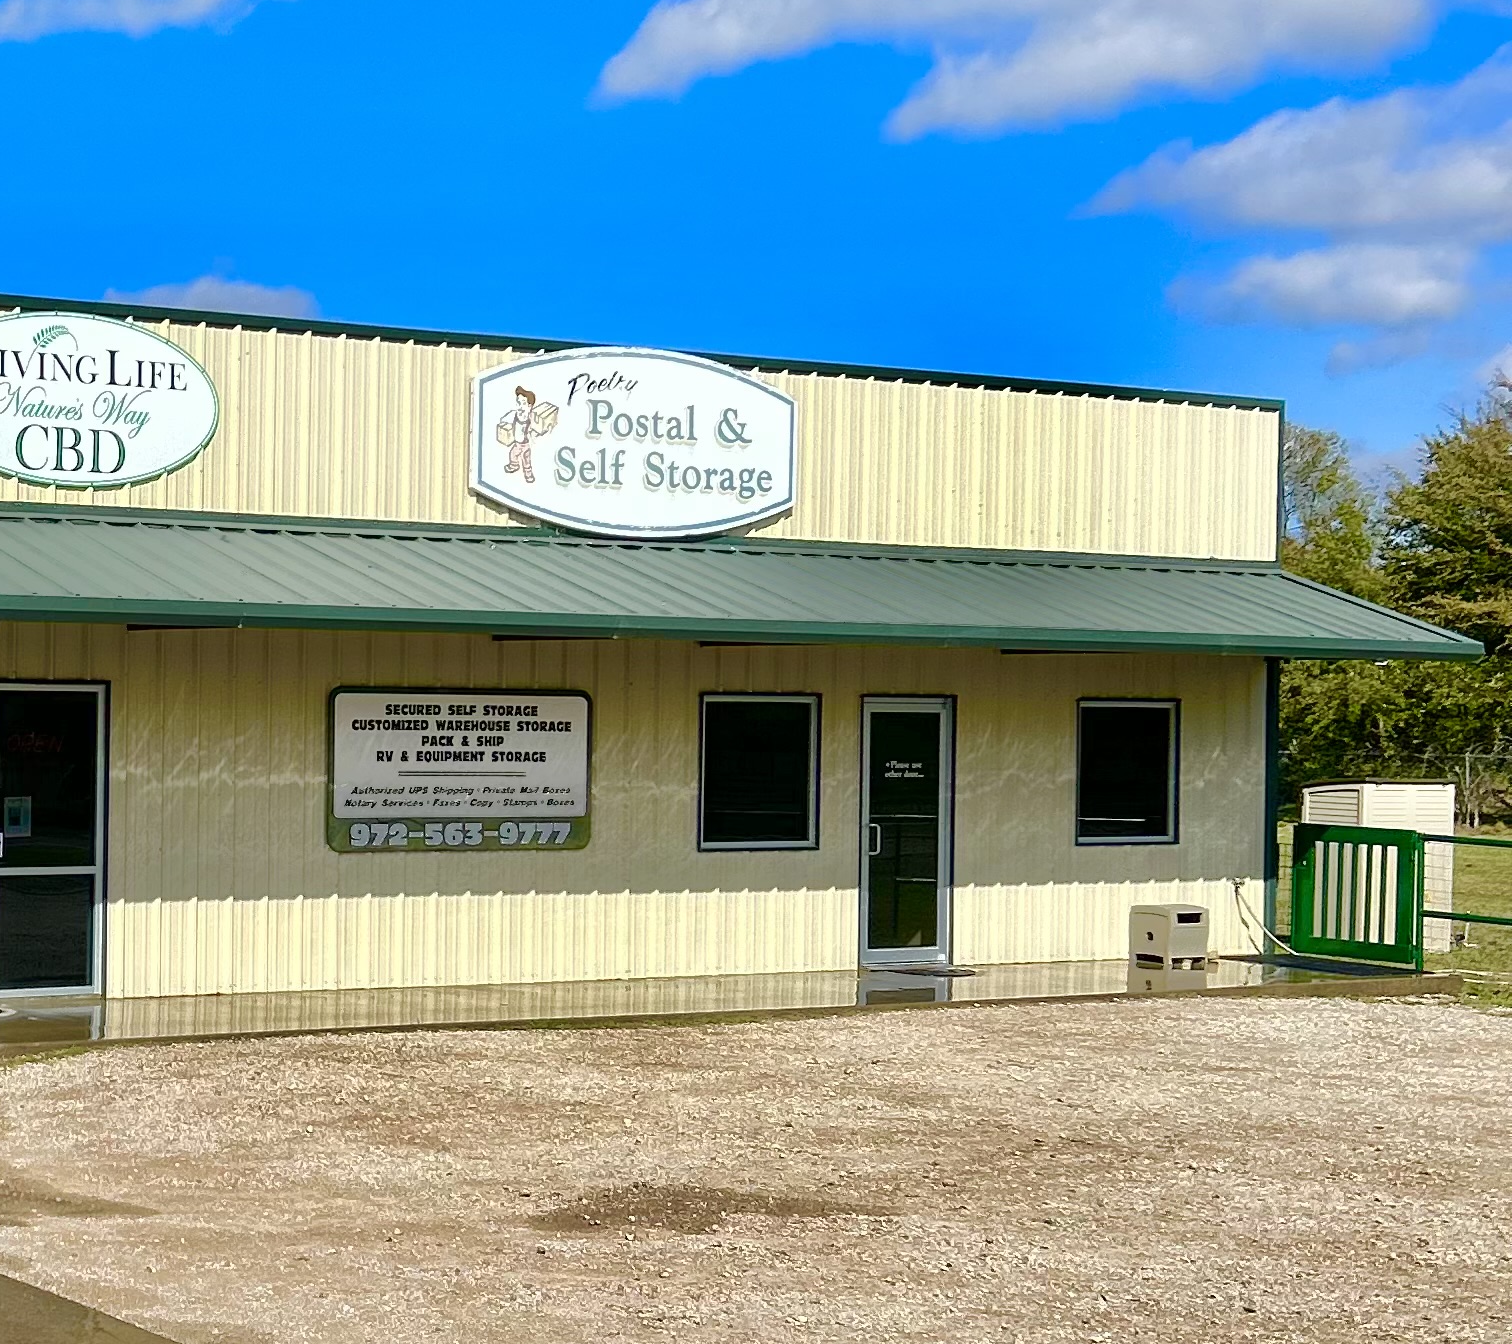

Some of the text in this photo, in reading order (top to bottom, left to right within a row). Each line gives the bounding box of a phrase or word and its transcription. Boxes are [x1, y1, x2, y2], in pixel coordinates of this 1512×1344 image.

[106, 349, 188, 391] LIFE
[567, 370, 639, 405] Poetry
[93, 390, 153, 439] Way
[586, 399, 753, 447] Postal &
[15, 424, 126, 474] CBD
[554, 446, 773, 502] Self Storage
[385, 704, 538, 717] SECURED SELF STORAGE
[352, 719, 572, 732] CUSTOMIZED WAREHOUSE STORAGE
[421, 735, 505, 747] PACK & SHIP
[376, 751, 547, 763] RV & EQUIPMENT STORAGE
[344, 798, 377, 809] Notary
[381, 798, 424, 807] Services
[469, 798, 494, 808] Copy
[503, 798, 538, 808] Stamps
[546, 798, 575, 807] Boxes
[350, 786, 571, 796] Authorized UPS Shipping Private Mail Boxes
[349, 822, 571, 847] 972-563-9777
